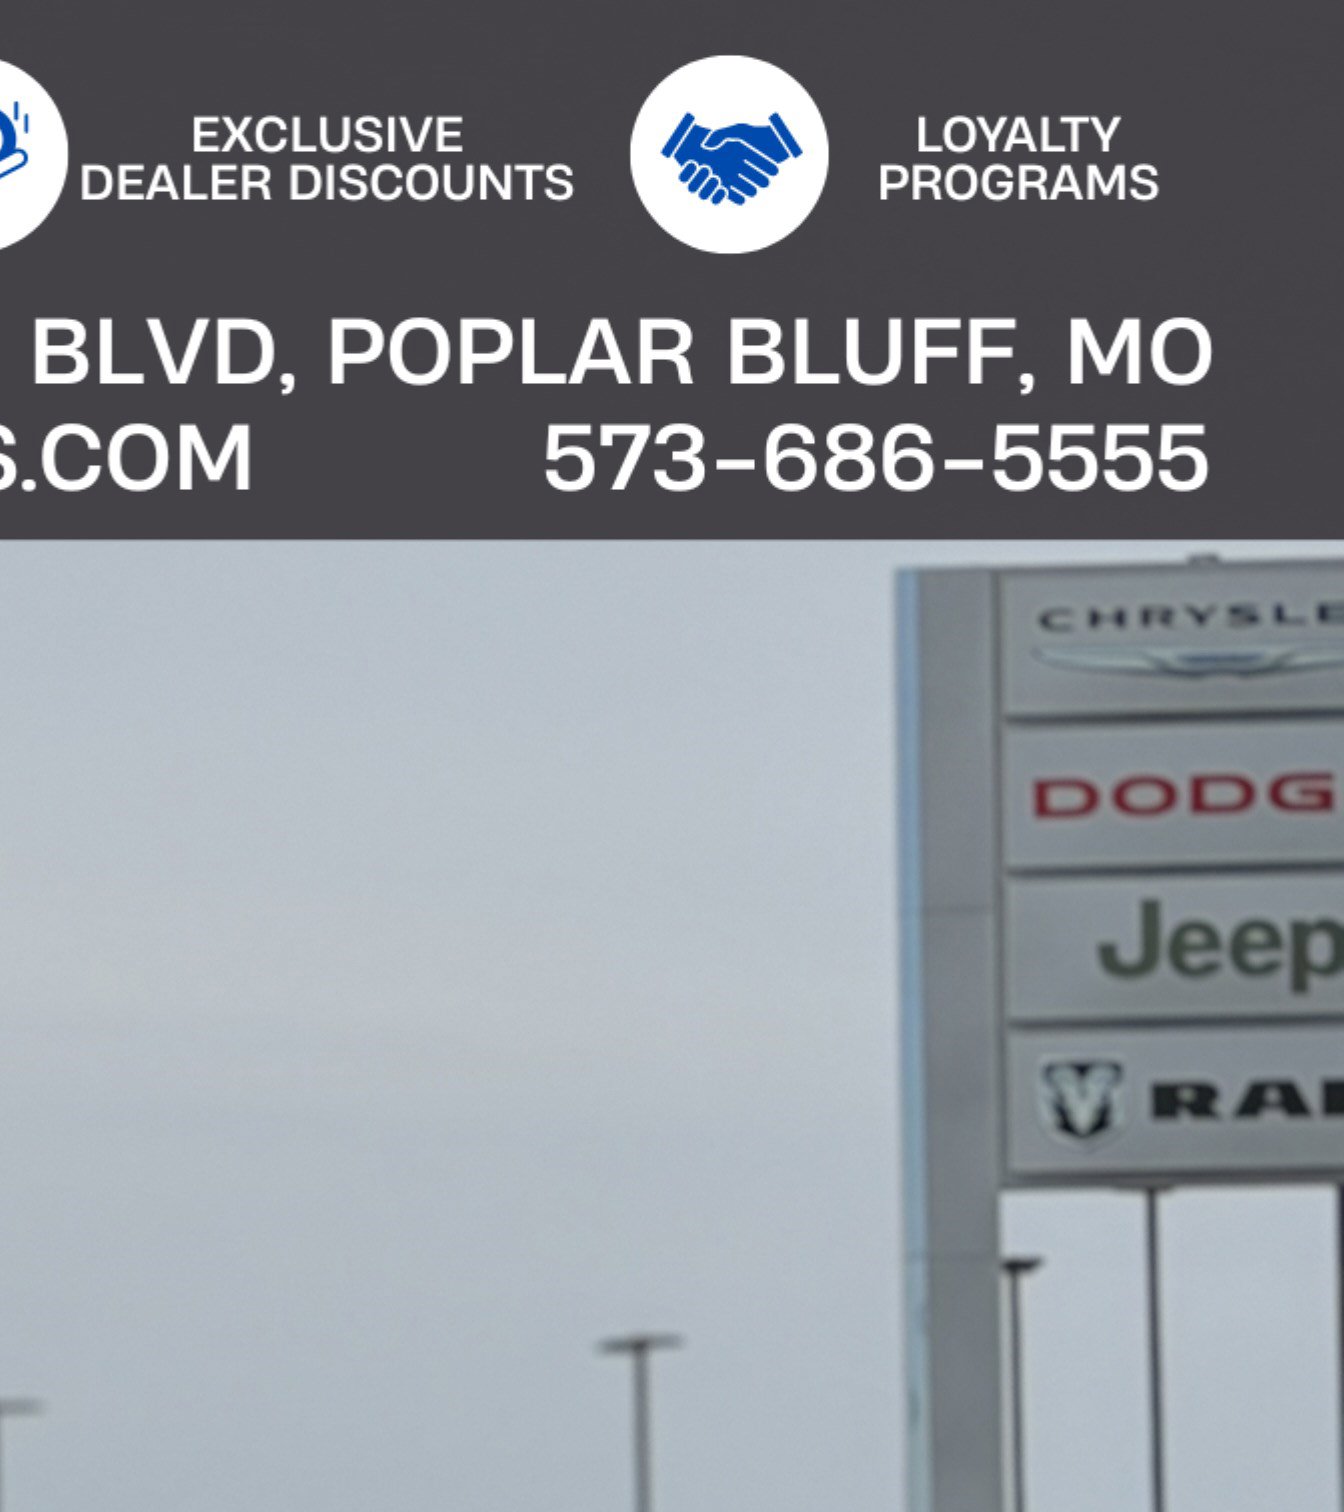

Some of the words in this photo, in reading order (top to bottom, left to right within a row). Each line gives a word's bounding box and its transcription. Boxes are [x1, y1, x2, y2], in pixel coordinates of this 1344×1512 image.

[1032, 772, 1335, 820] DODG
[1098, 898, 1344, 995] Jeep
[1150, 1080, 1344, 1119] RA
